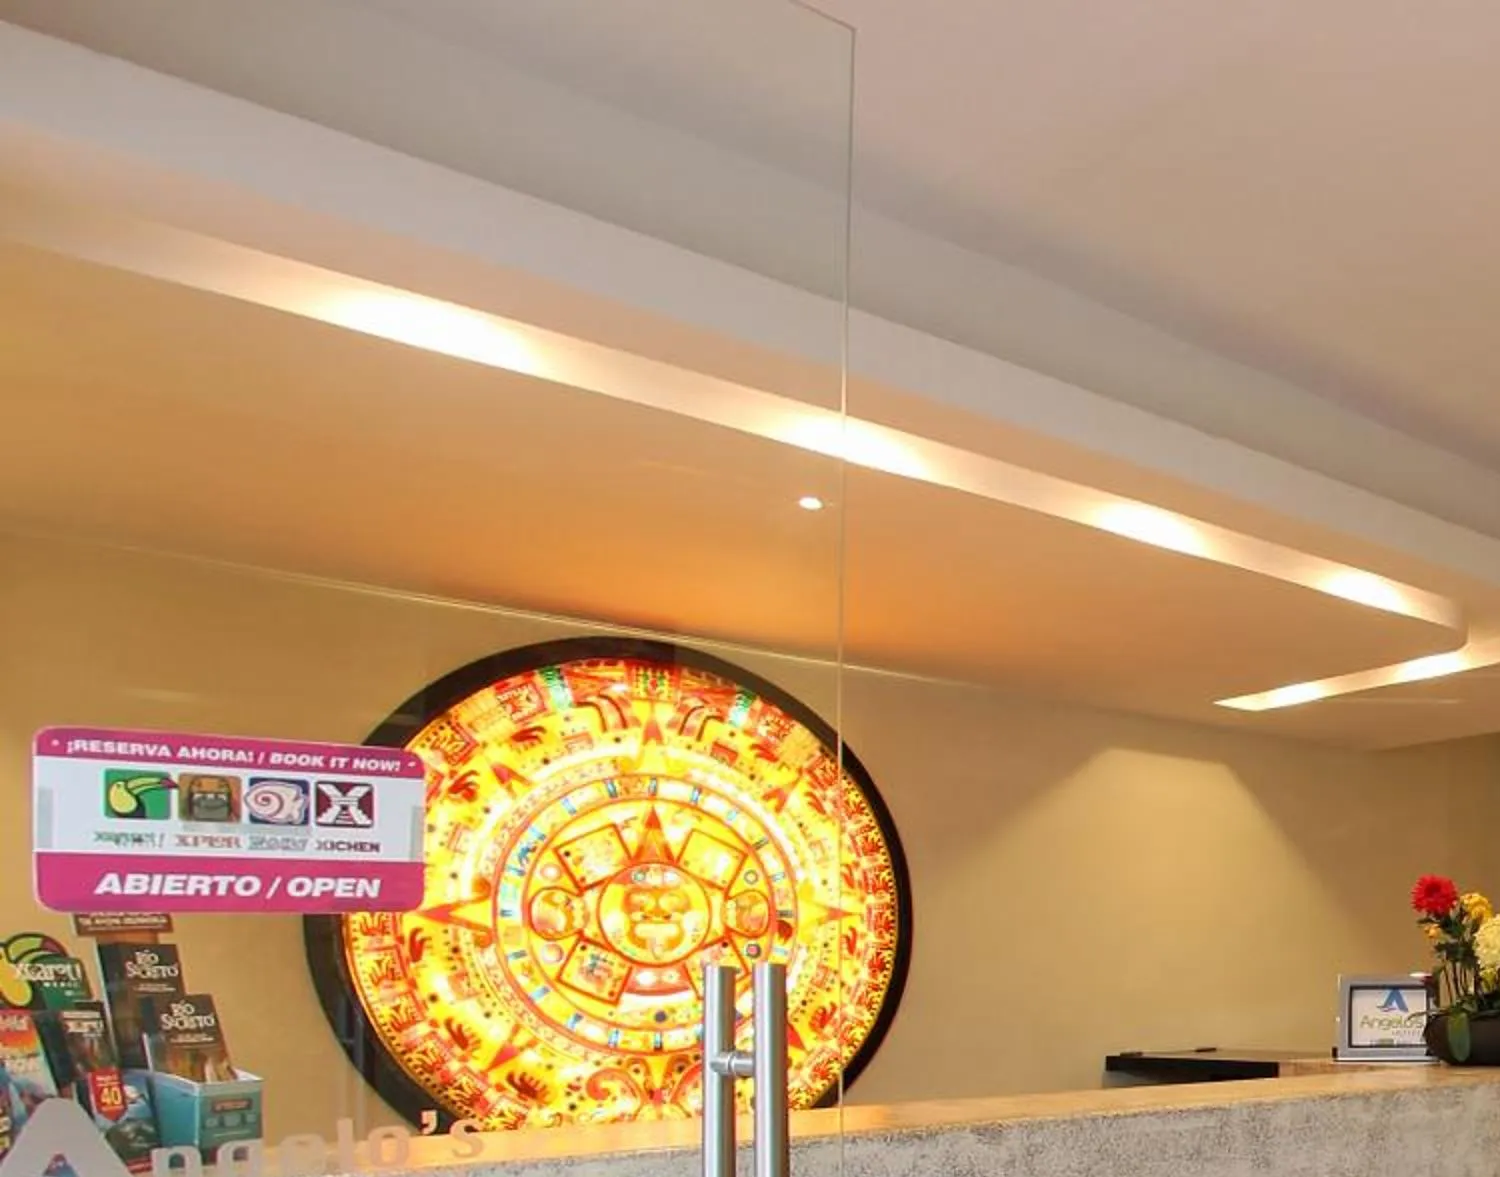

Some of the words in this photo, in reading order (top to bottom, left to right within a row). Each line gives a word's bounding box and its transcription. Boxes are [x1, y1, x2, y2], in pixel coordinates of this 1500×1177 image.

[67, 739, 171, 757] ¡RESERVA
[177, 745, 254, 763] AHORA!
[269, 752, 325, 768] BOOK
[329, 756, 350, 769] IT
[352, 758, 401, 772] NOW!
[94, 872, 261, 898] ABIERTO
[266, 876, 282, 900] /
[286, 877, 381, 899] OPEN
